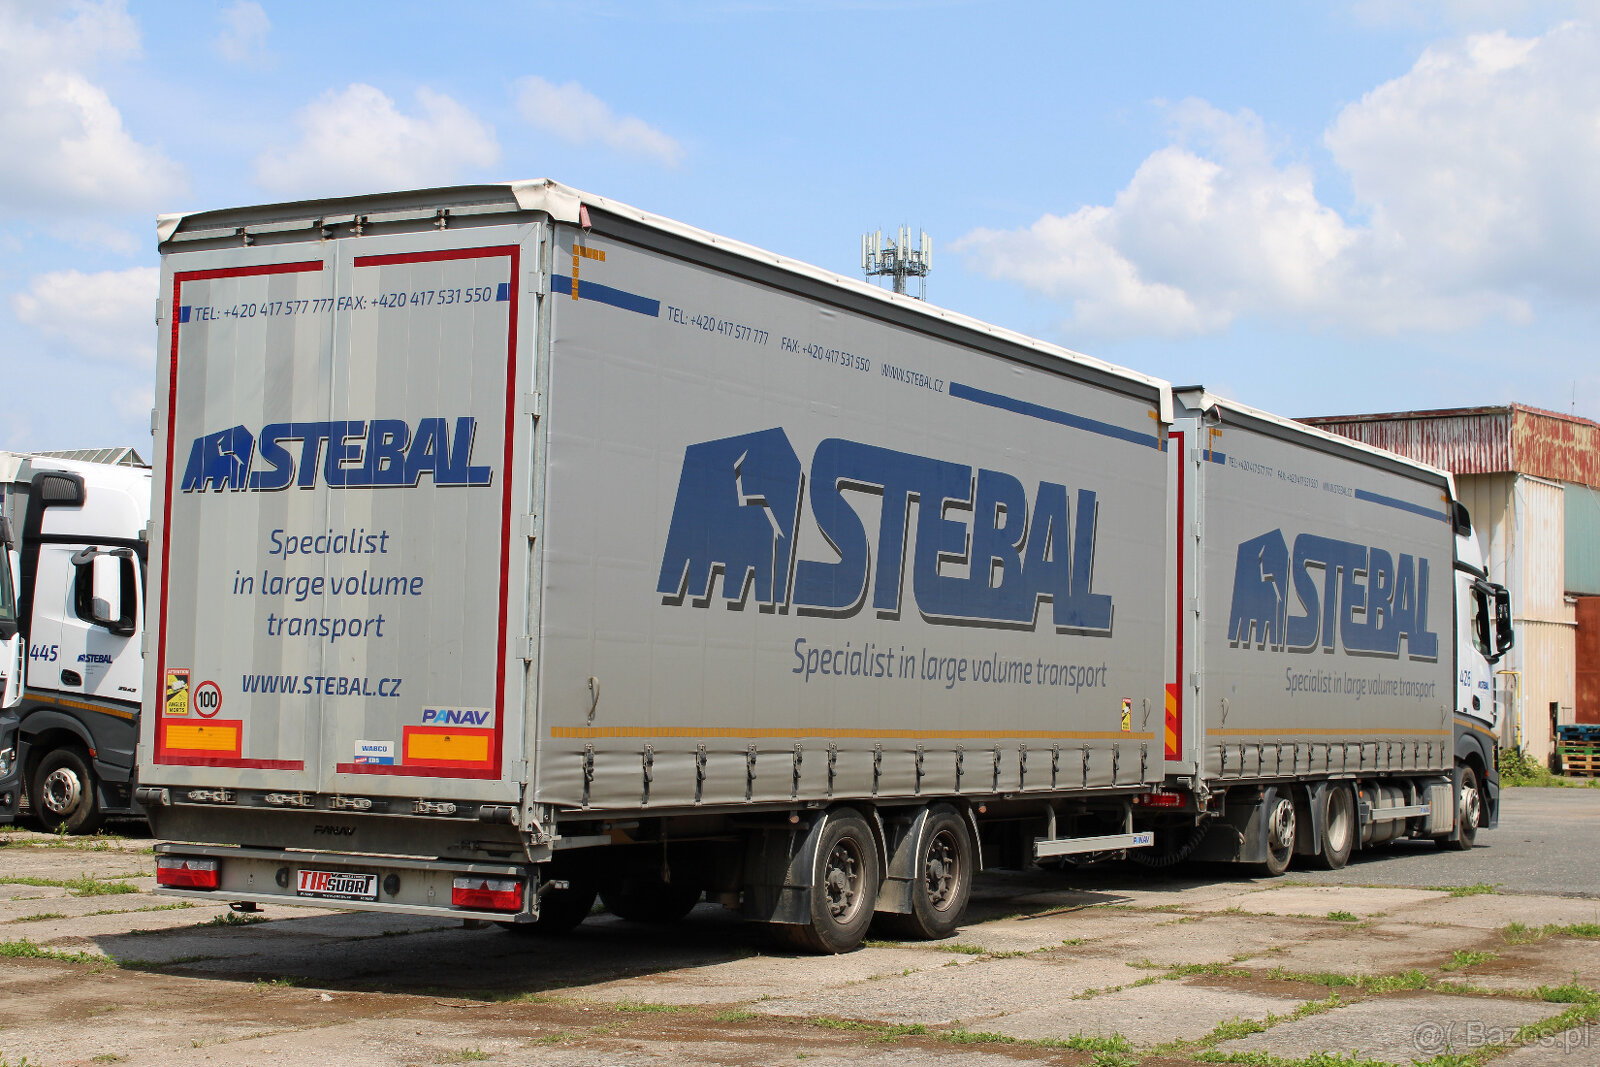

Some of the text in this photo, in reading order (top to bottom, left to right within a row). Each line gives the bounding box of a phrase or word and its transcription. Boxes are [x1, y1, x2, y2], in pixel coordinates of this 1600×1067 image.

[195, 299, 335, 322] TEL: +420 417 577 777
[336, 287, 492, 311] FAX: +420 417 531 550
[668, 305, 769, 345] TEL: +420 417 577 777
[780, 336, 871, 373] FAX: +420 417 531 550
[880, 362, 944, 393] WWW.STEBAL.CZ
[249, 417, 493, 492] STEBAL
[269, 529, 390, 560] Specialist
[792, 437, 1114, 638] STEBAL
[233, 570, 424, 601] in large volume
[1286, 533, 1438, 663] STEBAL
[267, 613, 386, 643] transport
[30, 644, 59, 662] 445
[84, 653, 113, 664] STEBAL
[792, 637, 1108, 693] Specialist in large volume transport
[198, 691, 218, 708] 100
[242, 674, 402, 698] WWW.STEBAL.CZ
[1285, 667, 1436, 702] Specialist in large volume transport
[422, 709, 491, 725] PANAV
[362, 745, 388, 753] WABCO
